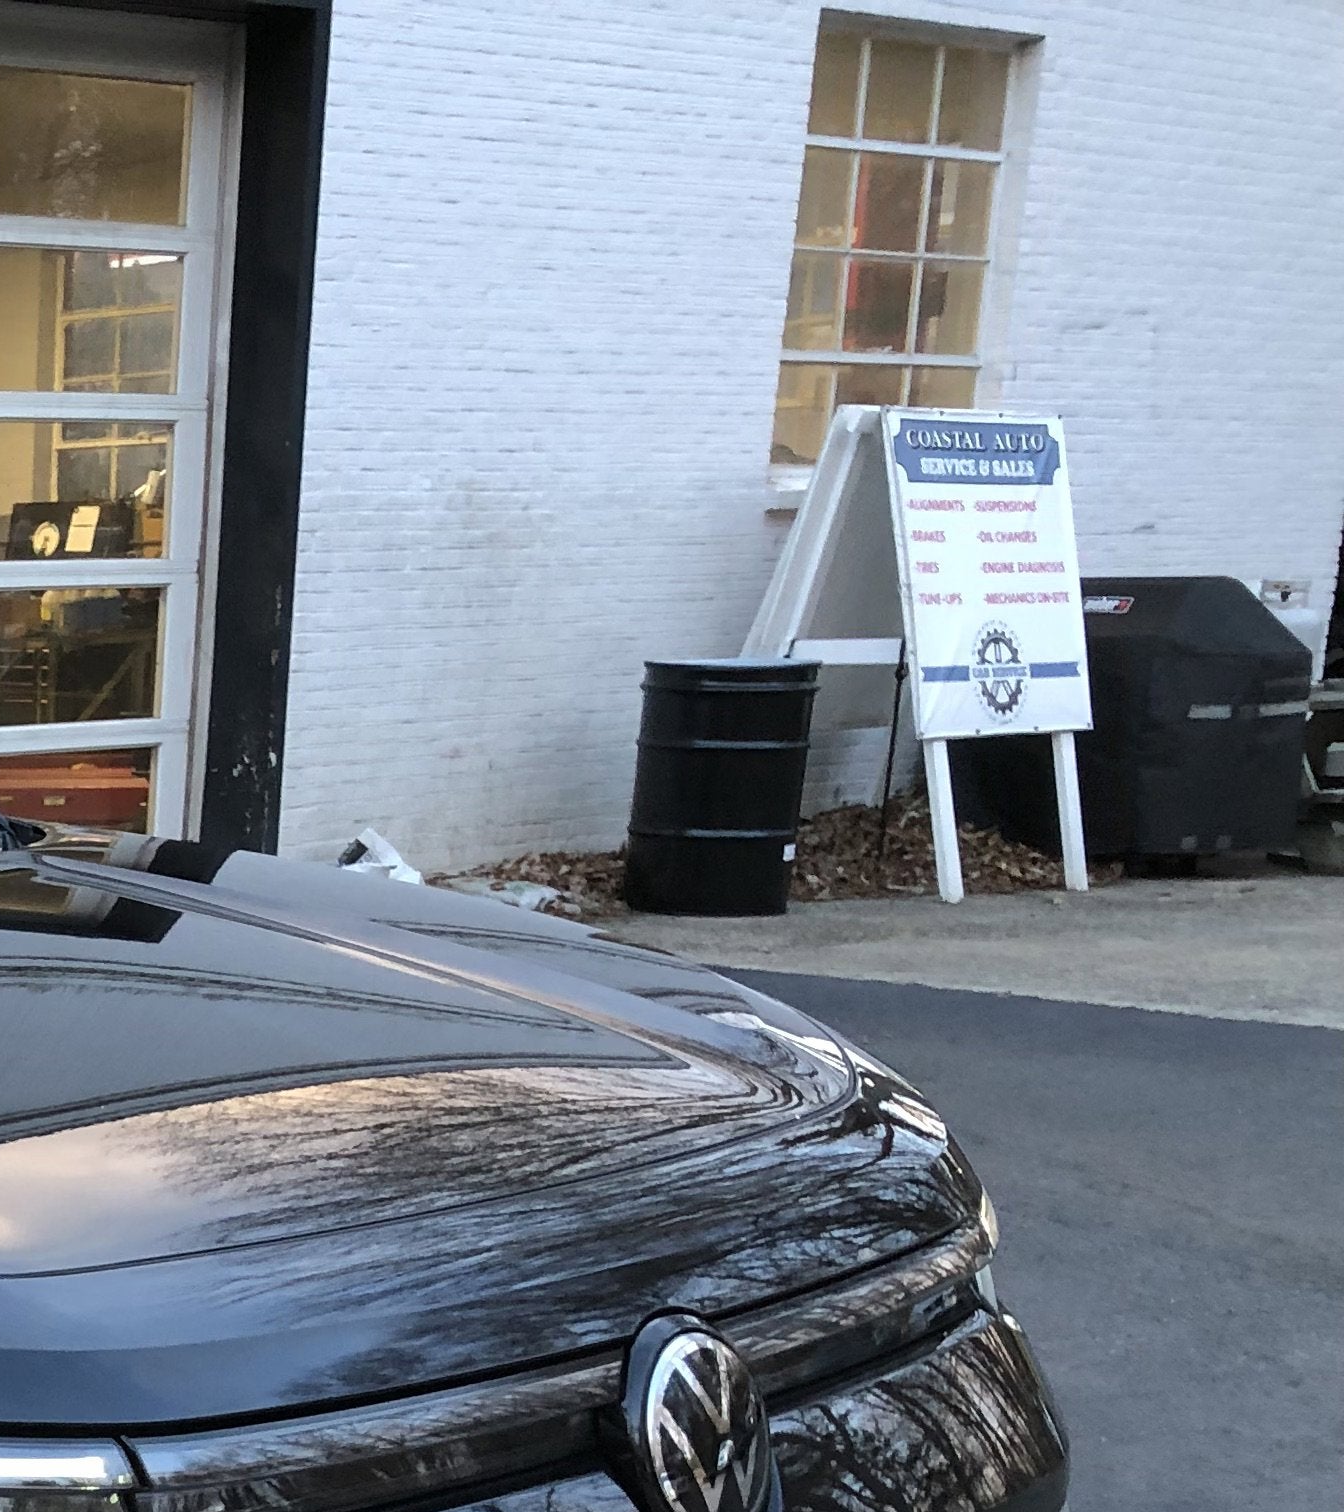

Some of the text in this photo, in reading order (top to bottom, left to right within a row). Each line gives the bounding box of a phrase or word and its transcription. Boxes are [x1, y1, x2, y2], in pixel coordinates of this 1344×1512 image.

[905, 428, 1046, 453] COASTAL AUTO
[919, 456, 978, 477] SERVICE
[991, 459, 1036, 477] SALES
[995, 530, 1038, 544] CHANGES
[1017, 560, 1066, 574] DIAGNOSIS
